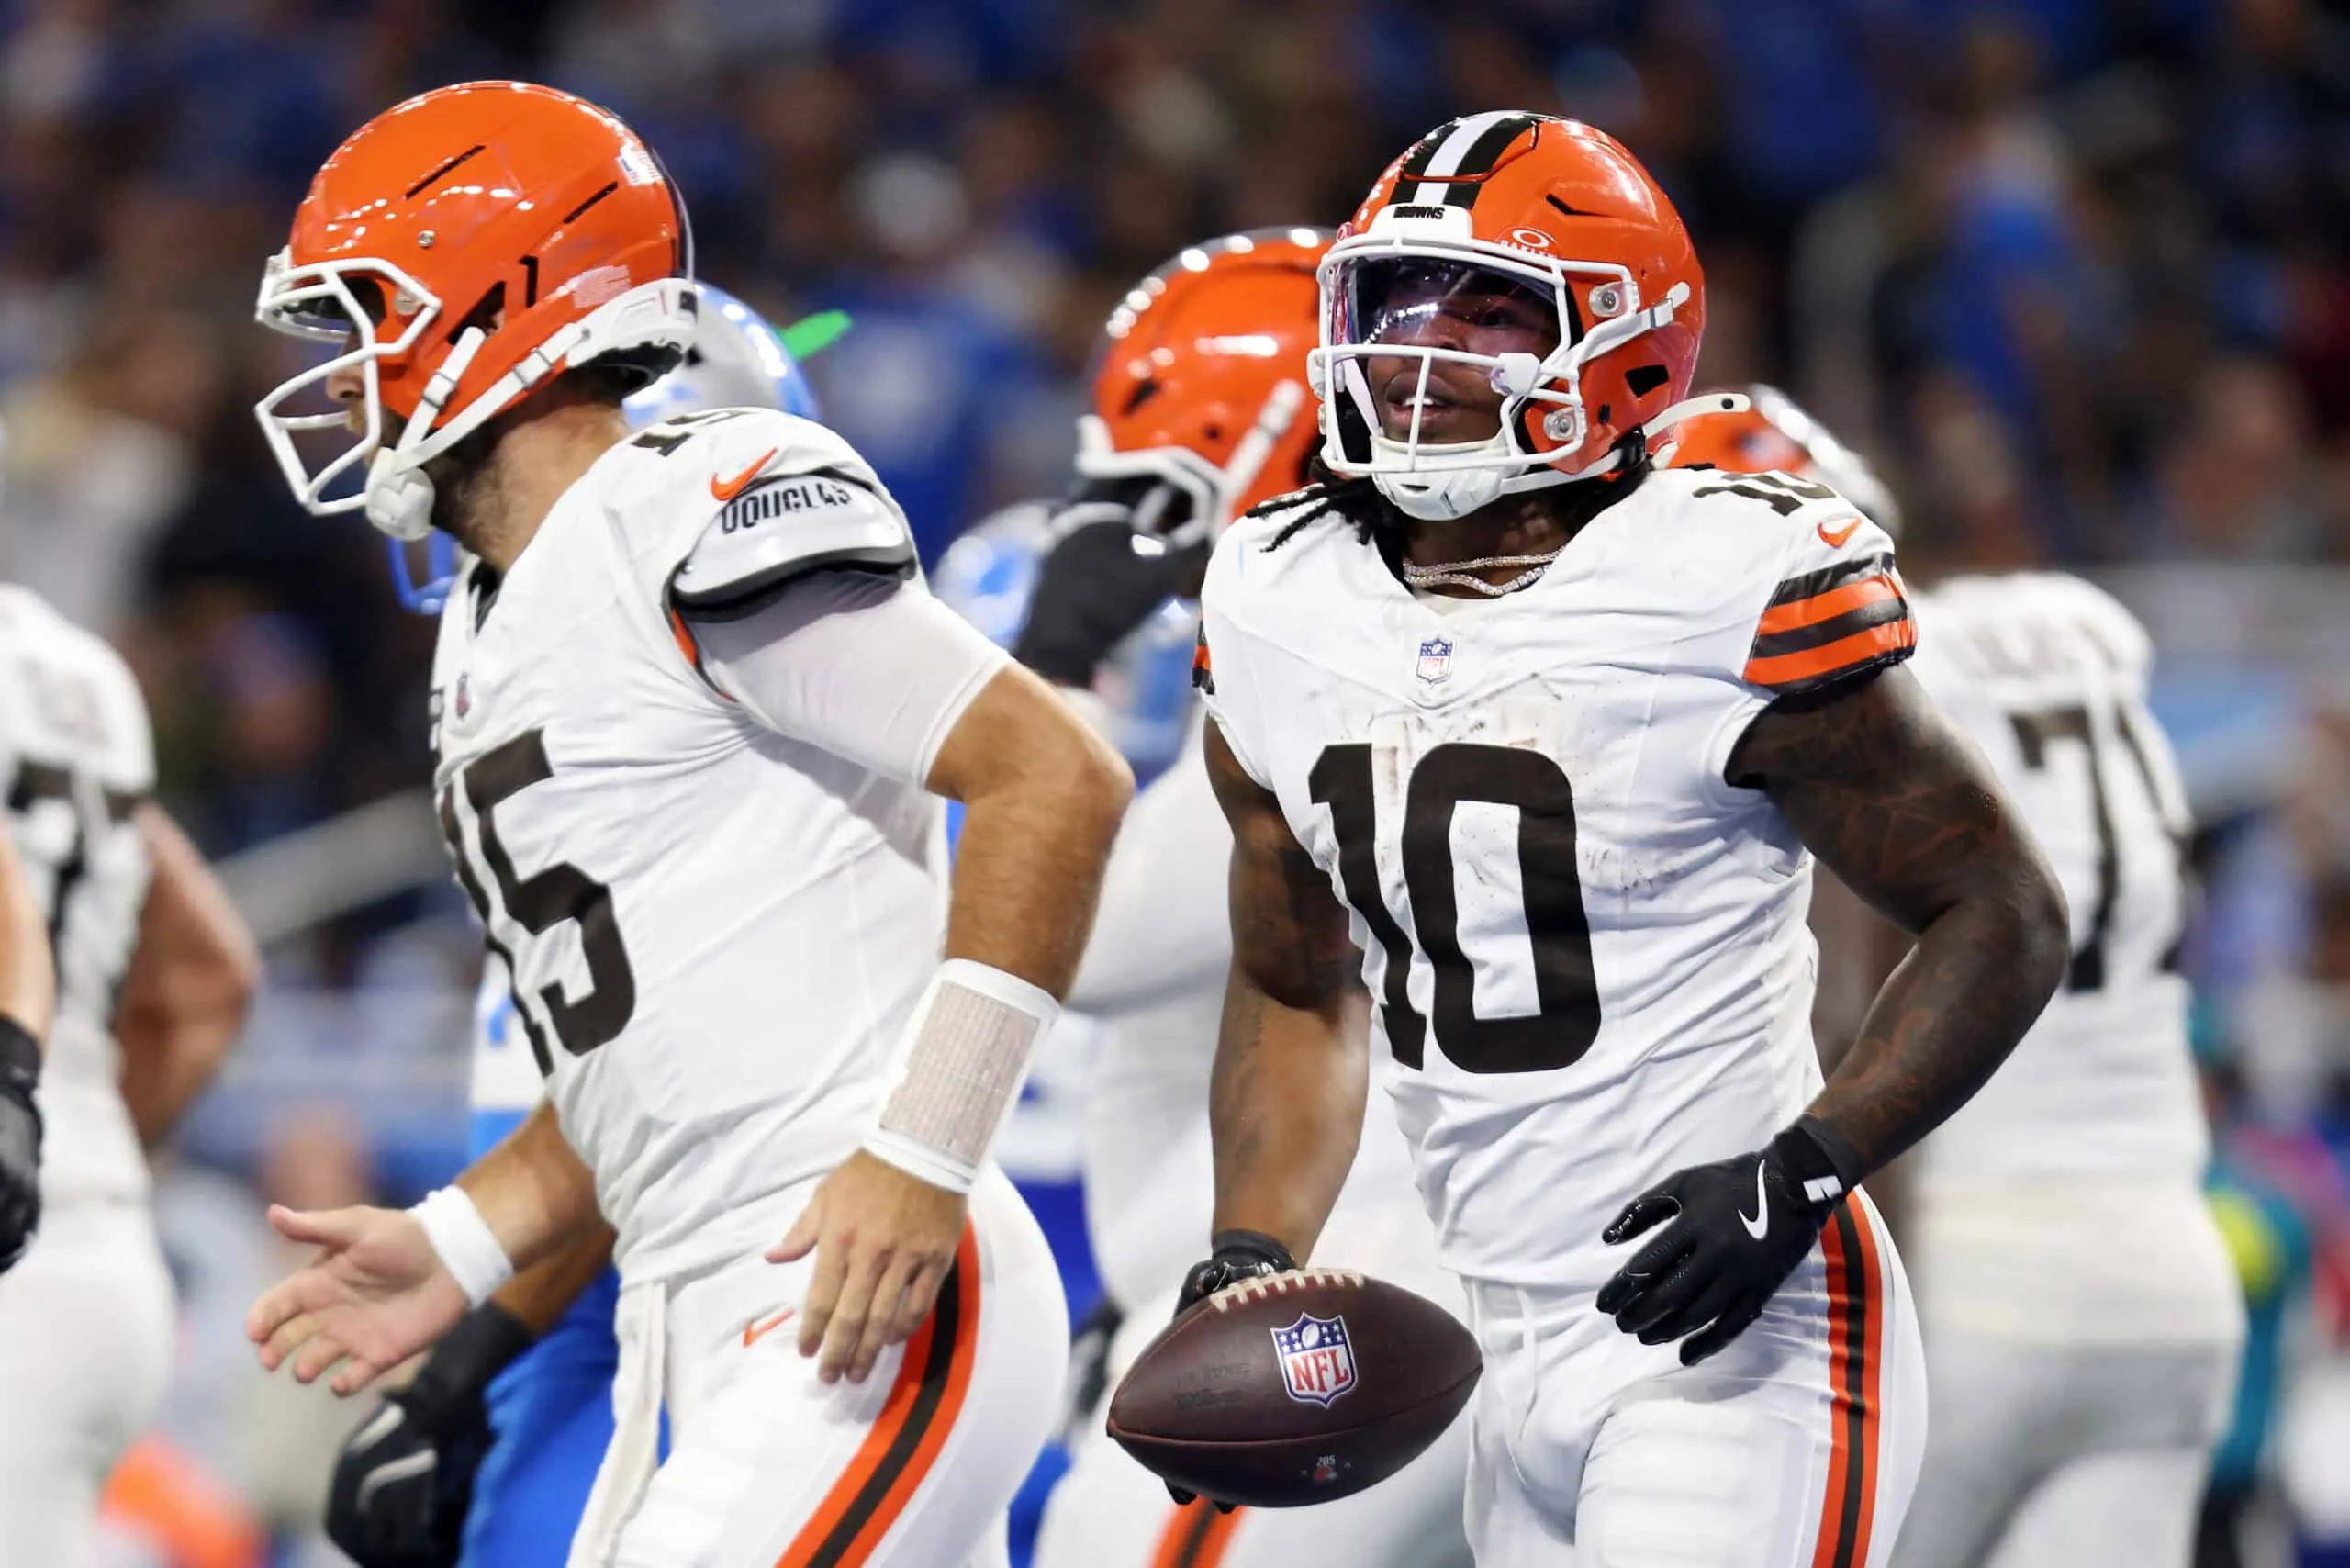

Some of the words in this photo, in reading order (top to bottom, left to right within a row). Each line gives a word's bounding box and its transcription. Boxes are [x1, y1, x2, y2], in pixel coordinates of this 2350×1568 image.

[441, 728, 636, 1078] 15
[1308, 742, 1602, 1074] 10
[1291, 1350, 1351, 1393] NFL
